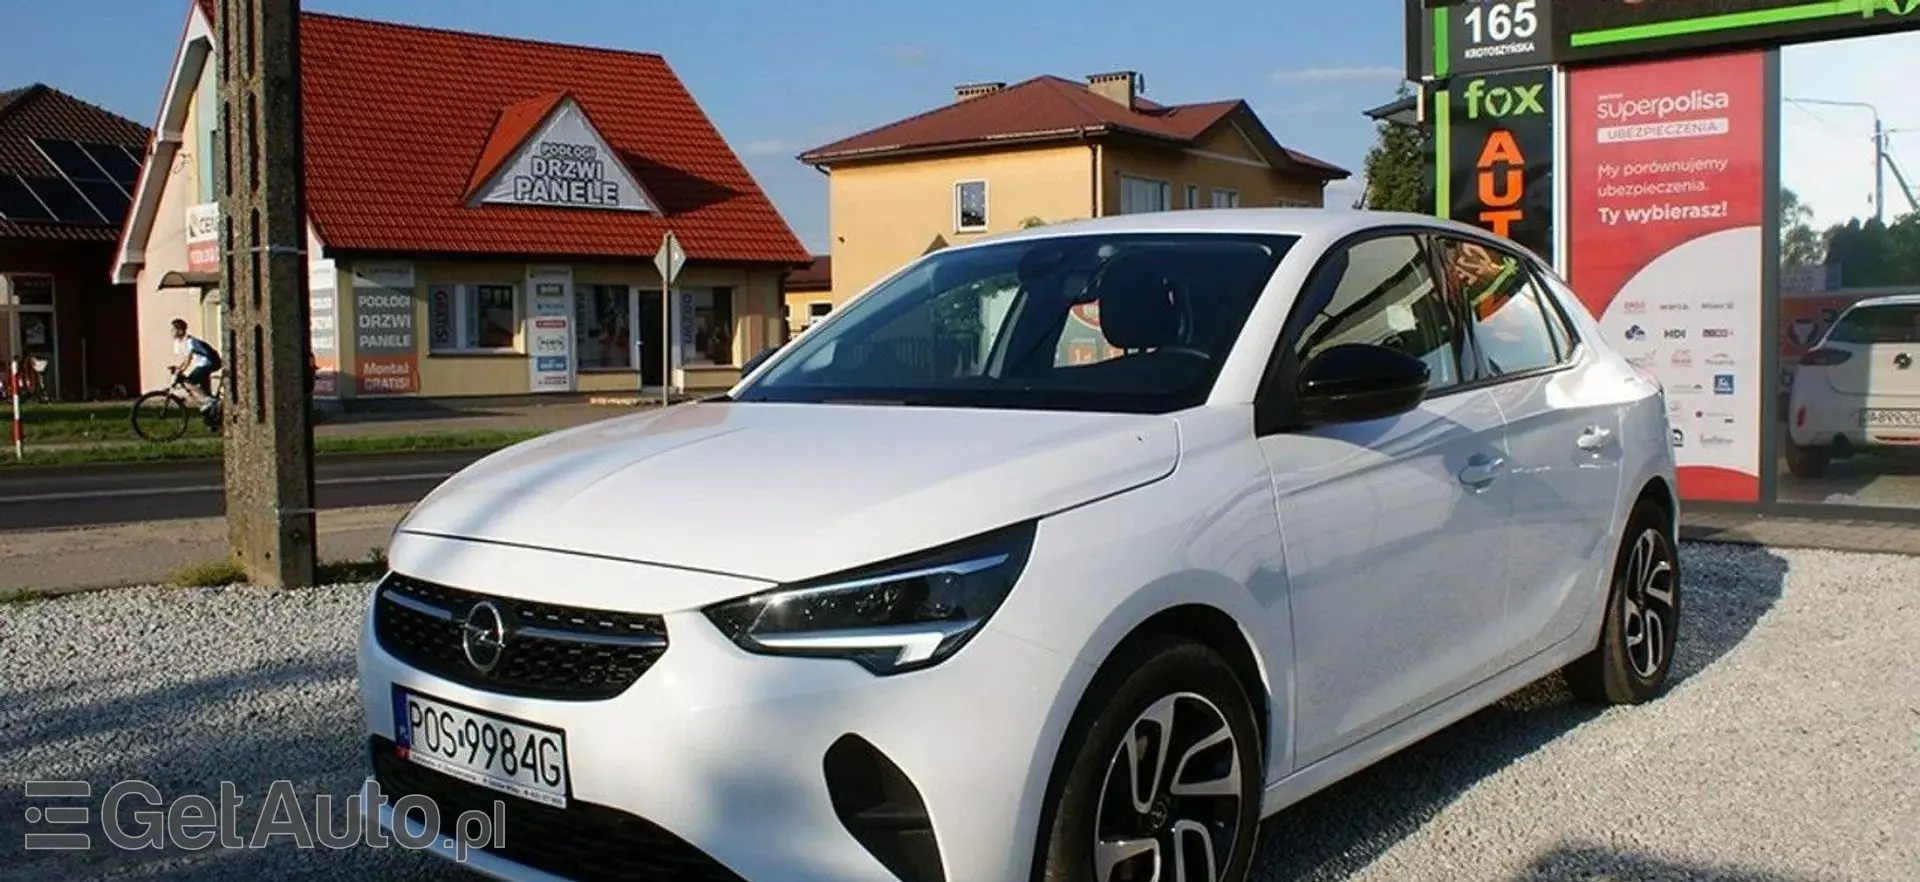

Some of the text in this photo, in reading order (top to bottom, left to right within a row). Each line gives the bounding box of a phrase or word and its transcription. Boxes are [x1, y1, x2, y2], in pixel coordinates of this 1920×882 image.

[1464, 0, 1537, 43] 165
[1464, 41, 1535, 58] KROTOSZYŃSKA
[1463, 79, 1544, 119] fox
[1597, 89, 1729, 121] superpolisa
[1608, 122, 1720, 140] UBEZPIECZENIA
[531, 156, 604, 181] DRZWI
[1598, 157, 1728, 179] My porównujemy
[514, 176, 620, 205] PANELE
[1477, 130, 1524, 238] AUT
[1598, 177, 1709, 198] ubezpieczenia.
[1598, 200, 1728, 225] Ty wybierasz!
[359, 314, 412, 329] DRZWI
[359, 333, 412, 348] PANELE
[408, 700, 562, 787] POS 9984G
